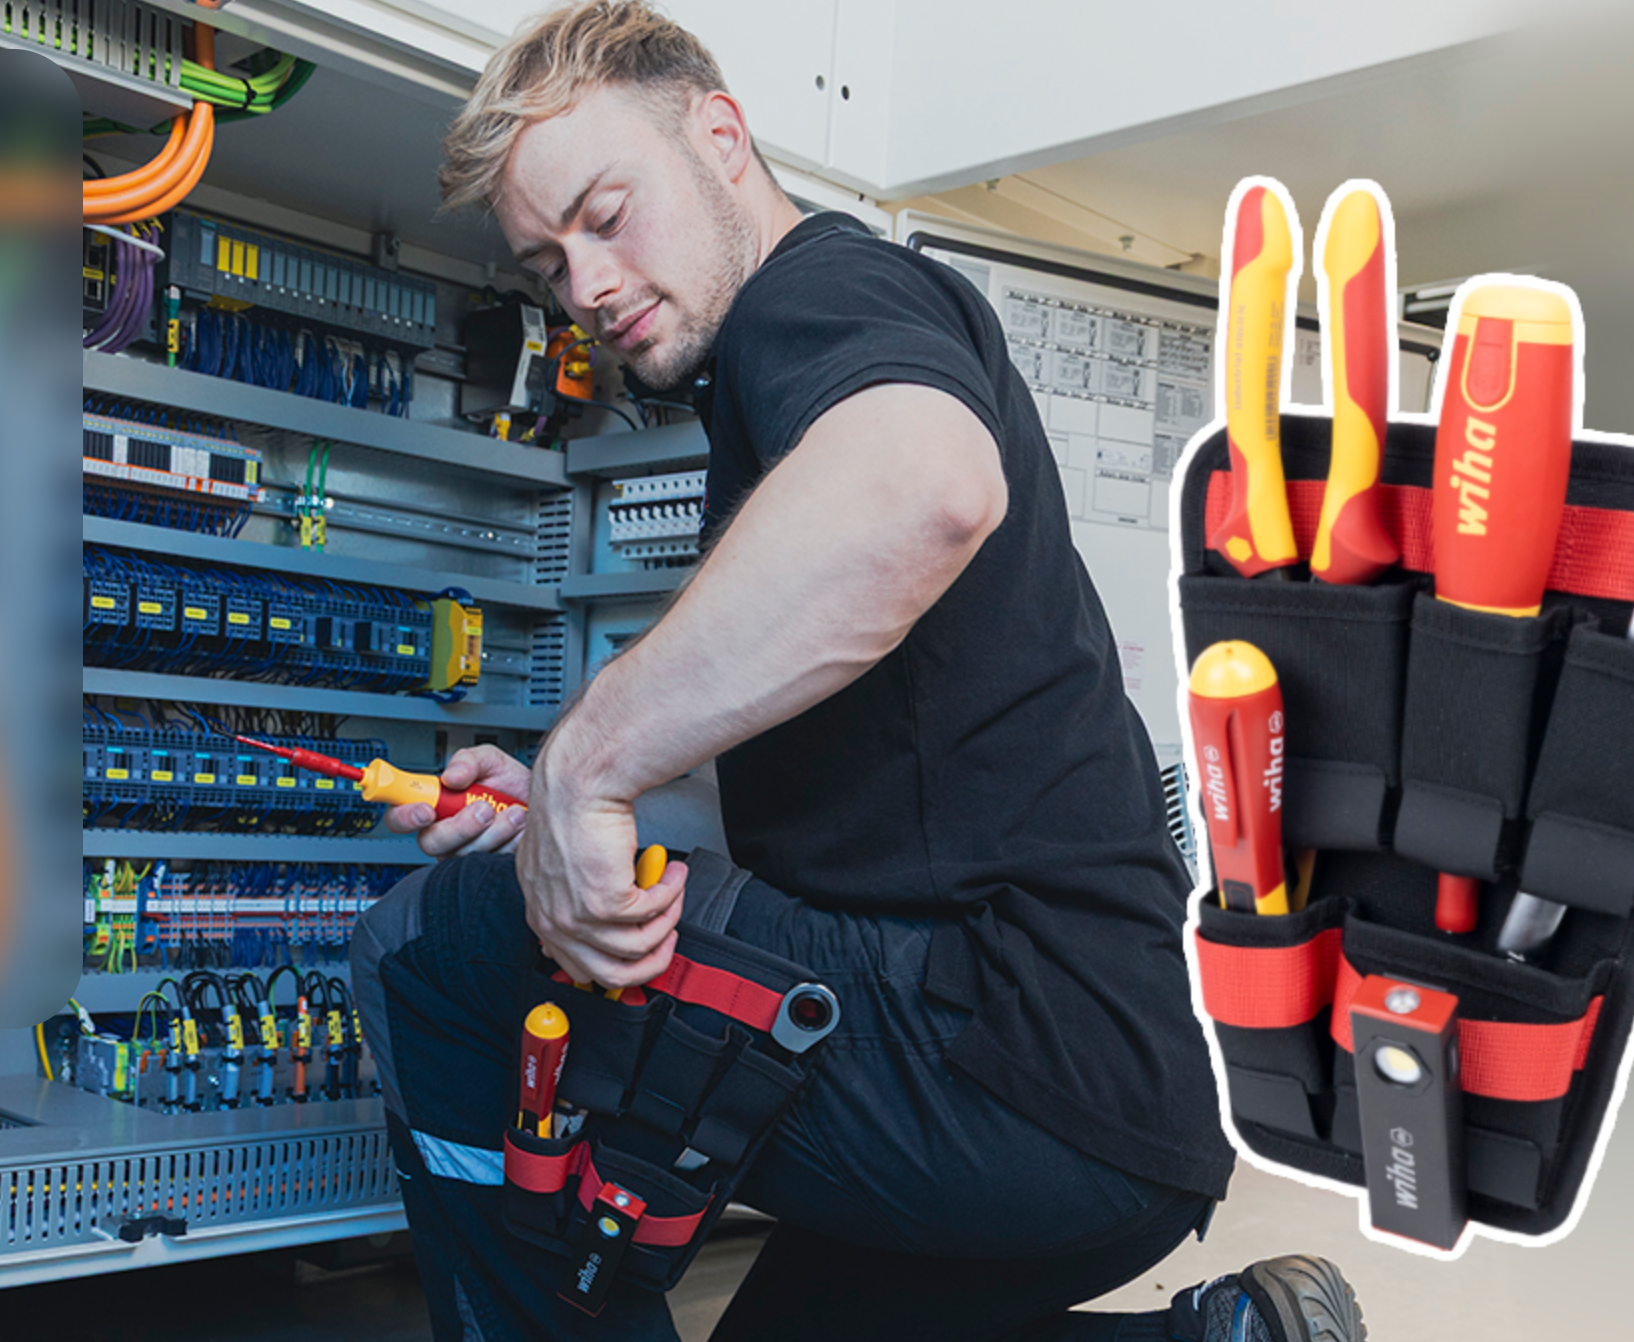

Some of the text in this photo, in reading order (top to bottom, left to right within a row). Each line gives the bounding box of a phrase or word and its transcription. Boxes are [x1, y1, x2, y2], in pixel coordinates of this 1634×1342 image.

[1450, 416, 1497, 536] wiha
[1206, 763, 1229, 821] wiha
[1263, 737, 1284, 813] wiha
[1385, 1146, 1418, 1210] wiha
